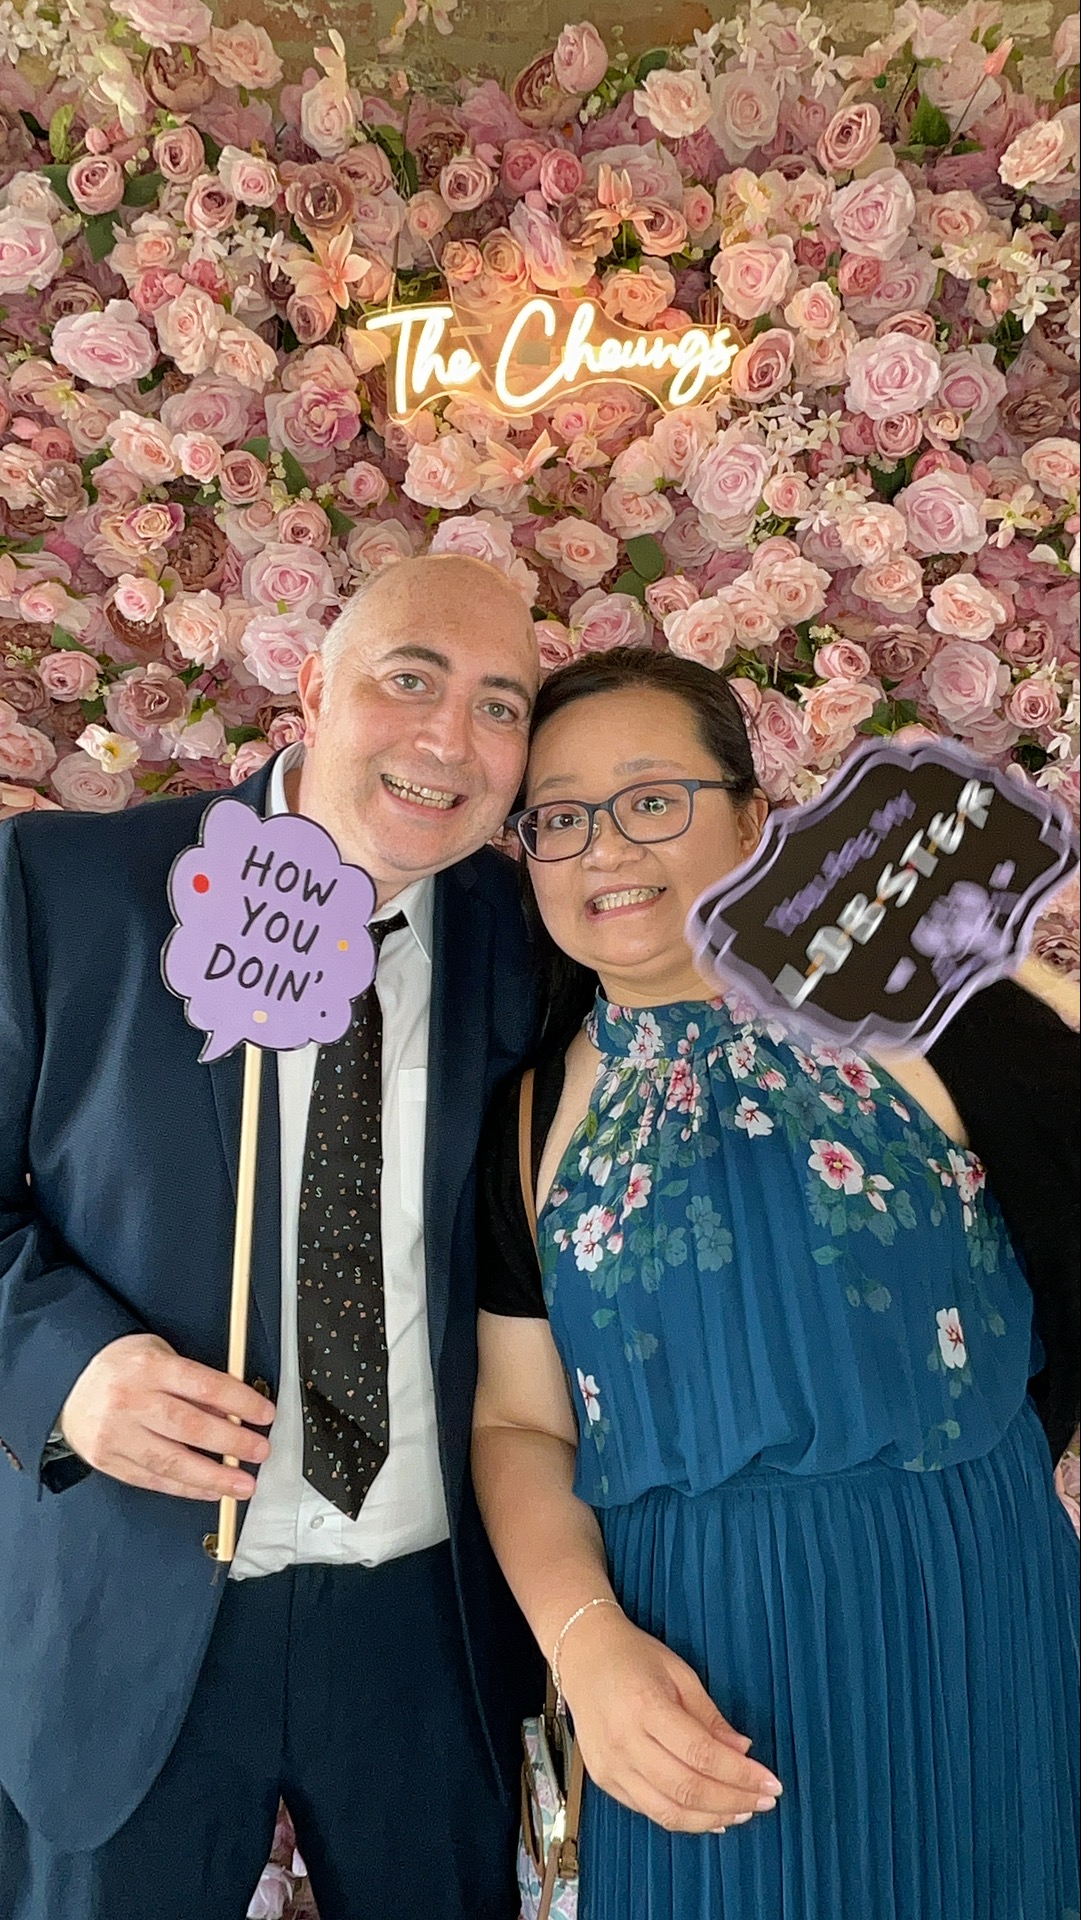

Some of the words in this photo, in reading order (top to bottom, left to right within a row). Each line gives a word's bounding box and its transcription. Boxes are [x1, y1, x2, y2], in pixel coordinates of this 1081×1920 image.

[365, 306, 481, 414] The
[495, 298, 739, 408] Cheungs
[241, 845, 338, 906] HOW
[773, 778, 995, 1009] LOBSTER
[241, 896, 320, 955] YOU
[204, 942, 324, 1002] DOIN'
